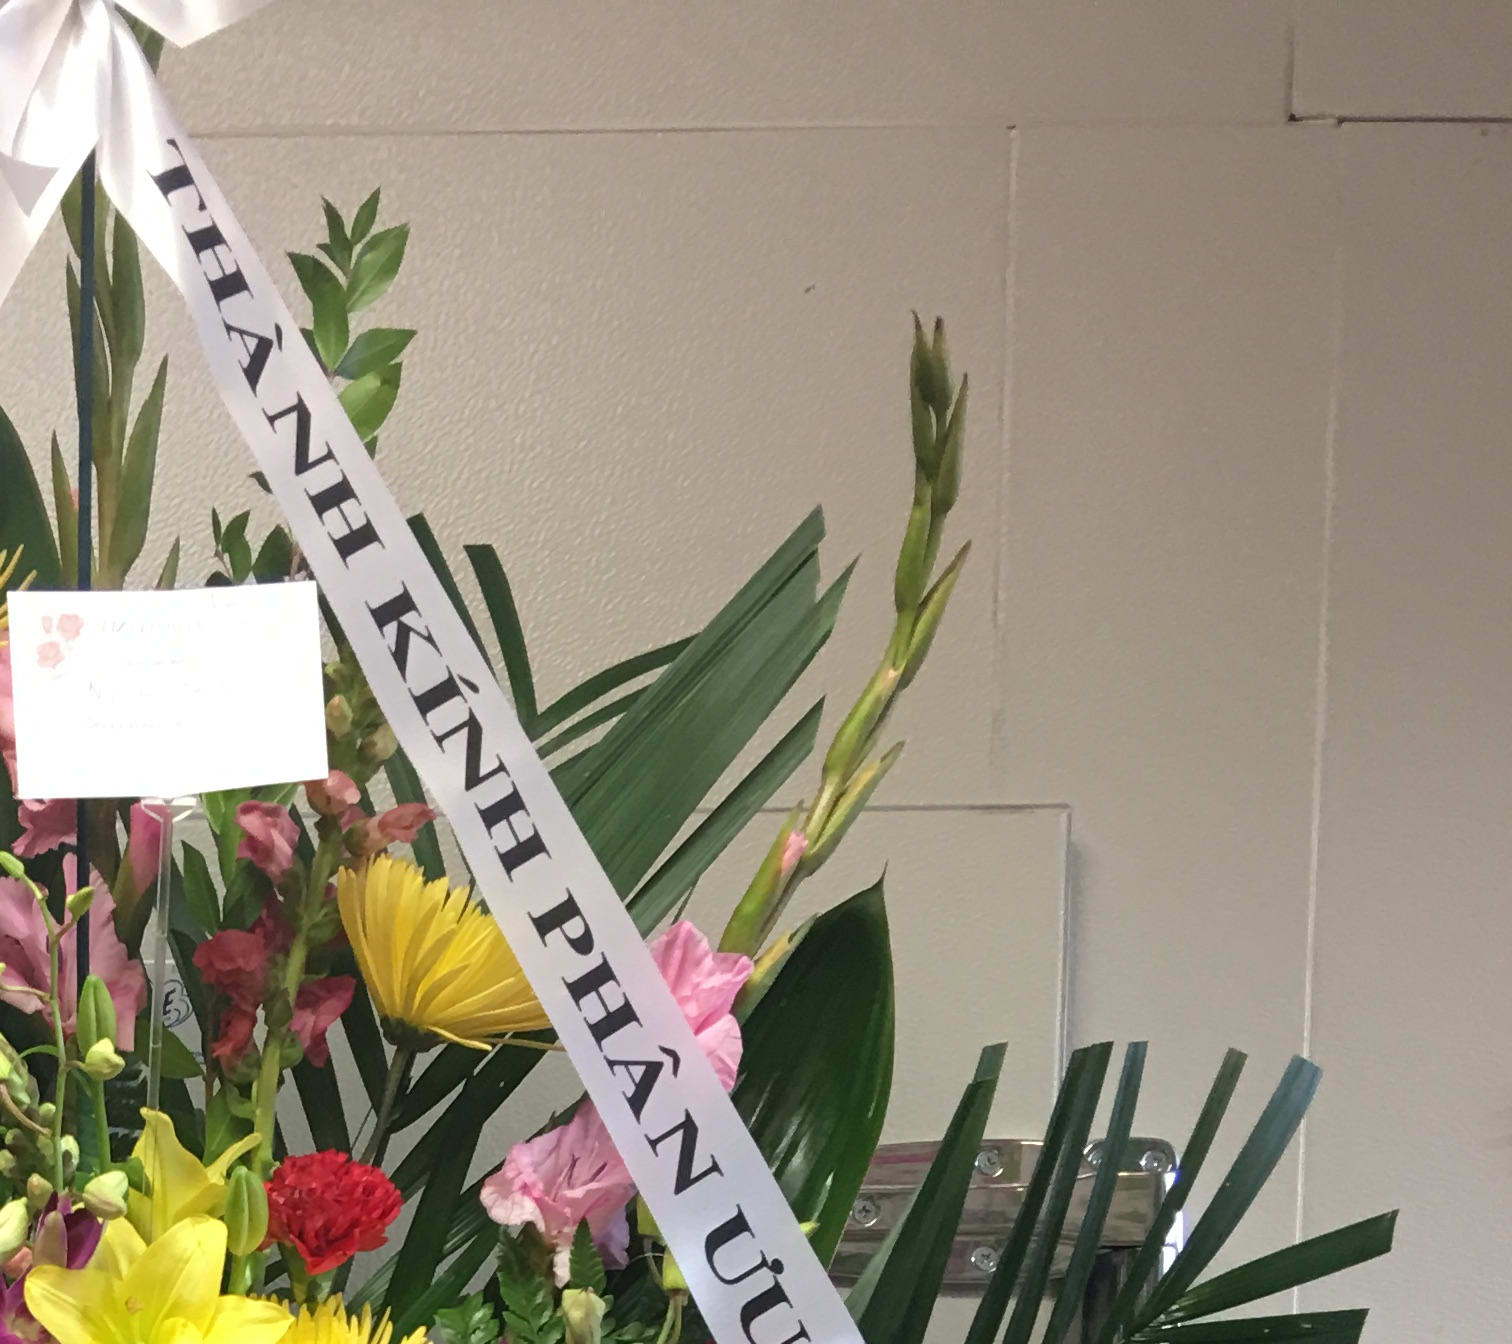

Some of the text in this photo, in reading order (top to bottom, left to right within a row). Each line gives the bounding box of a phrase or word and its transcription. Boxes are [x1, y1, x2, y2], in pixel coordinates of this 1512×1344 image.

[145, 138, 386, 569] THÀNH
[365, 580, 552, 882] KÍNH
[527, 887, 724, 1196] PHÂN
